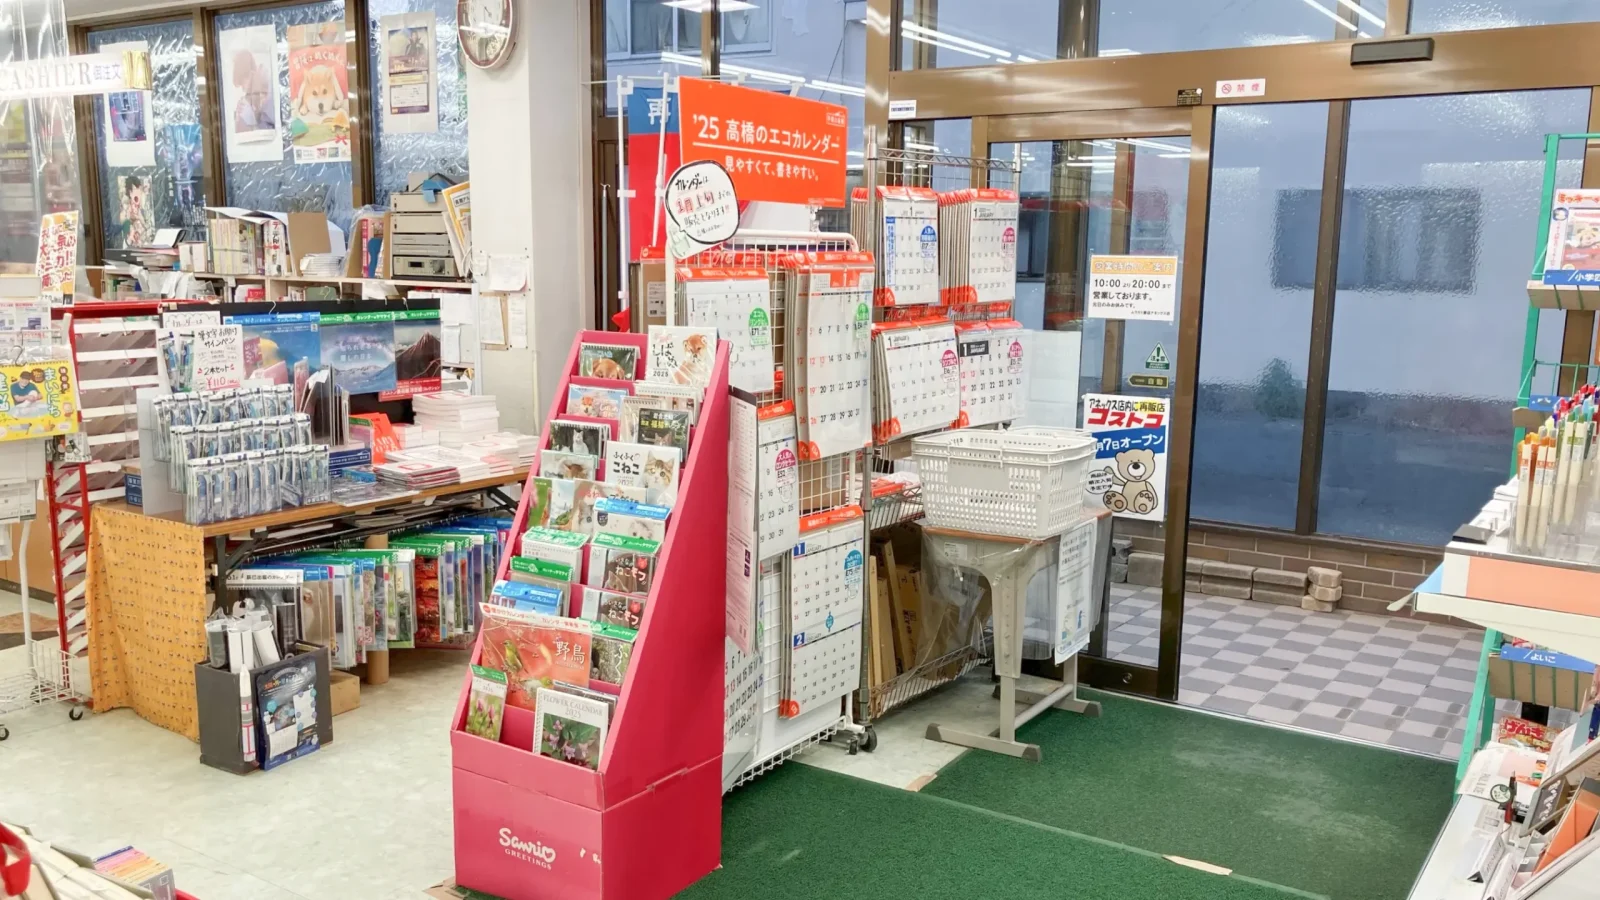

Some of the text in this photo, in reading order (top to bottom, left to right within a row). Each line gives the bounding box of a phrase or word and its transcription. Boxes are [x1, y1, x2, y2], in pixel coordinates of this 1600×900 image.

[693, 114, 840, 154] '25 高橋のエコカレンダー
[724, 155, 819, 182] 見やすくて、書きやすい。
[1094, 278, 1121, 288] 10:00
[1132, 280, 1161, 289] 20:00
[1092, 291, 1153, 301] 営業しております。
[963, 343, 968, 357] 1
[44, 366, 61, 418] まいにち
[1089, 398, 1165, 413] アネックス店内に再販店
[1088, 408, 1164, 428] コストコ
[613, 461, 640, 475] こねこ
[553, 640, 586, 665] 野鳥
[1530, 653, 1556, 663] よいこ
[498, 827, 557, 863] Sanrio
[504, 848, 552, 870] GREETINGS
